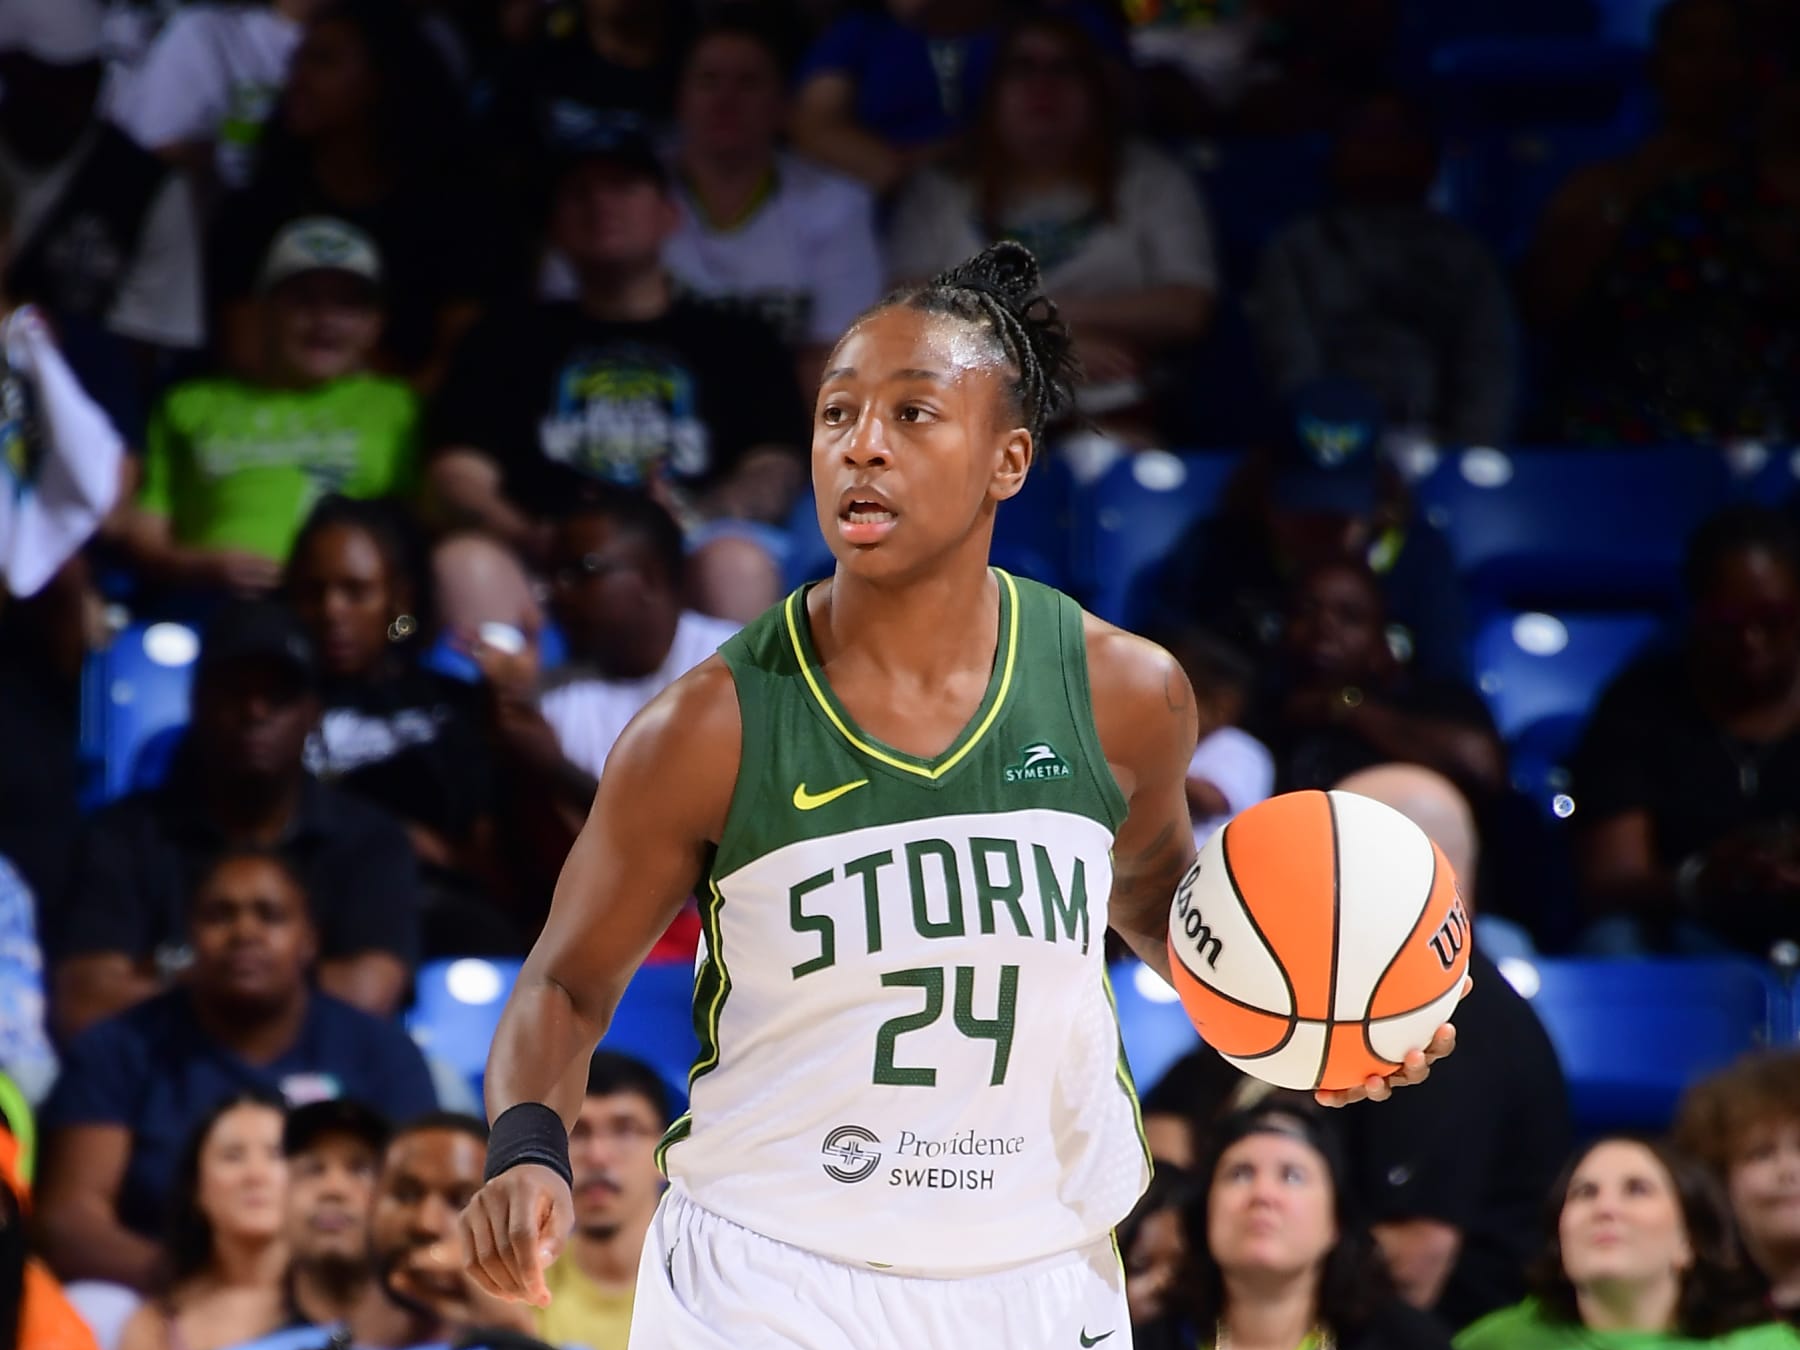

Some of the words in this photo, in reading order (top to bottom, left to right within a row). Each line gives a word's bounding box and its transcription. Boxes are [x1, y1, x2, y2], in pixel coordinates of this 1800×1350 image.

[1006, 765, 1069, 782] SYMETRA
[789, 837, 1089, 981] STORM
[872, 964, 1021, 1088] 24
[895, 1128, 1025, 1159] Providence
[889, 1167, 995, 1191] SWEDISH
